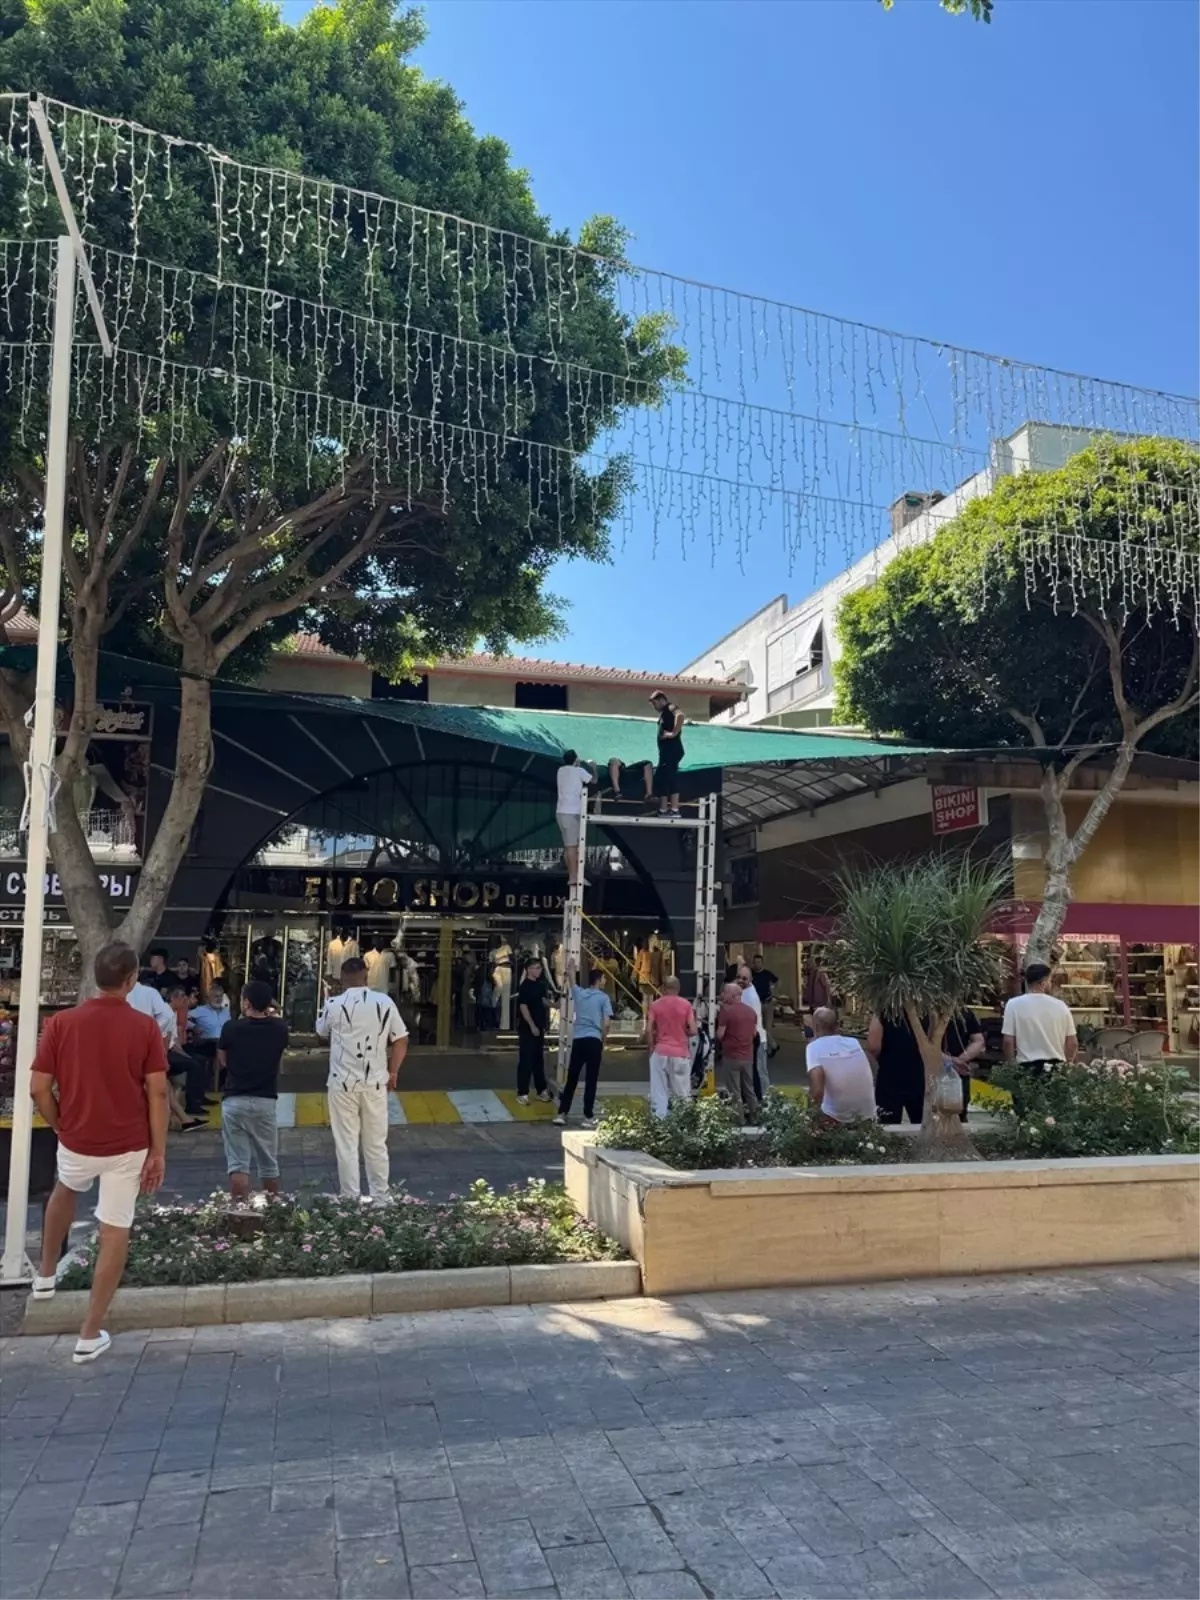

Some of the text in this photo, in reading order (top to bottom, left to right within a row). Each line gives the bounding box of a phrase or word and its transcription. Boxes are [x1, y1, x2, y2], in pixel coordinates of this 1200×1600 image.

[935, 790, 976, 810] BIKINI
[936, 804, 976, 822] SHOP
[304, 876, 399, 906] EURO
[412, 879, 500, 908] SHOP
